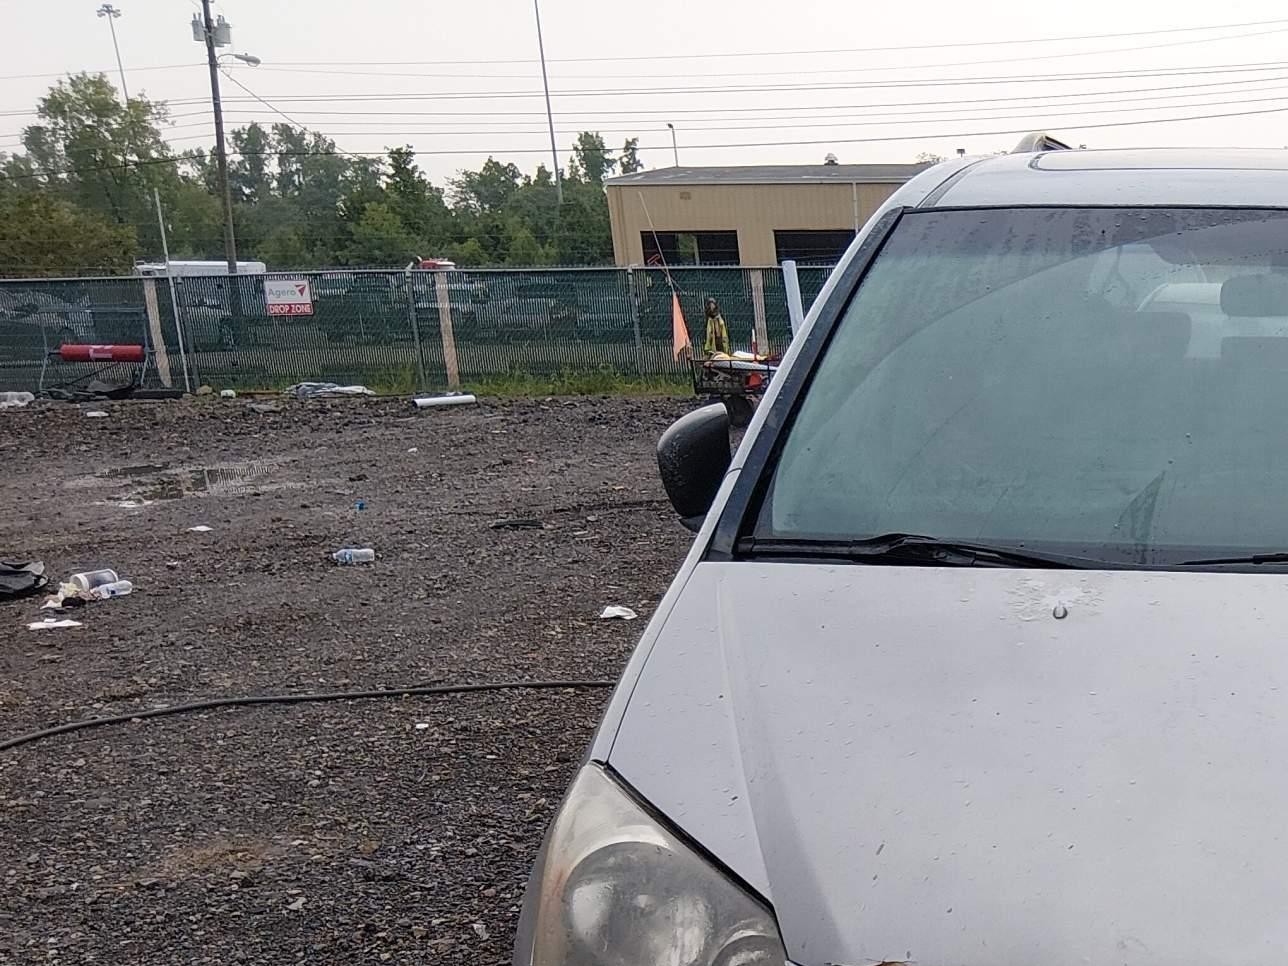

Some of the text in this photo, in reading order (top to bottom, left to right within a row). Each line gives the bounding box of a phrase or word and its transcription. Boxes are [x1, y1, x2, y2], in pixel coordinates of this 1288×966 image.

[268, 288, 297, 298] Agero
[269, 304, 311, 314] DROP ZONE
